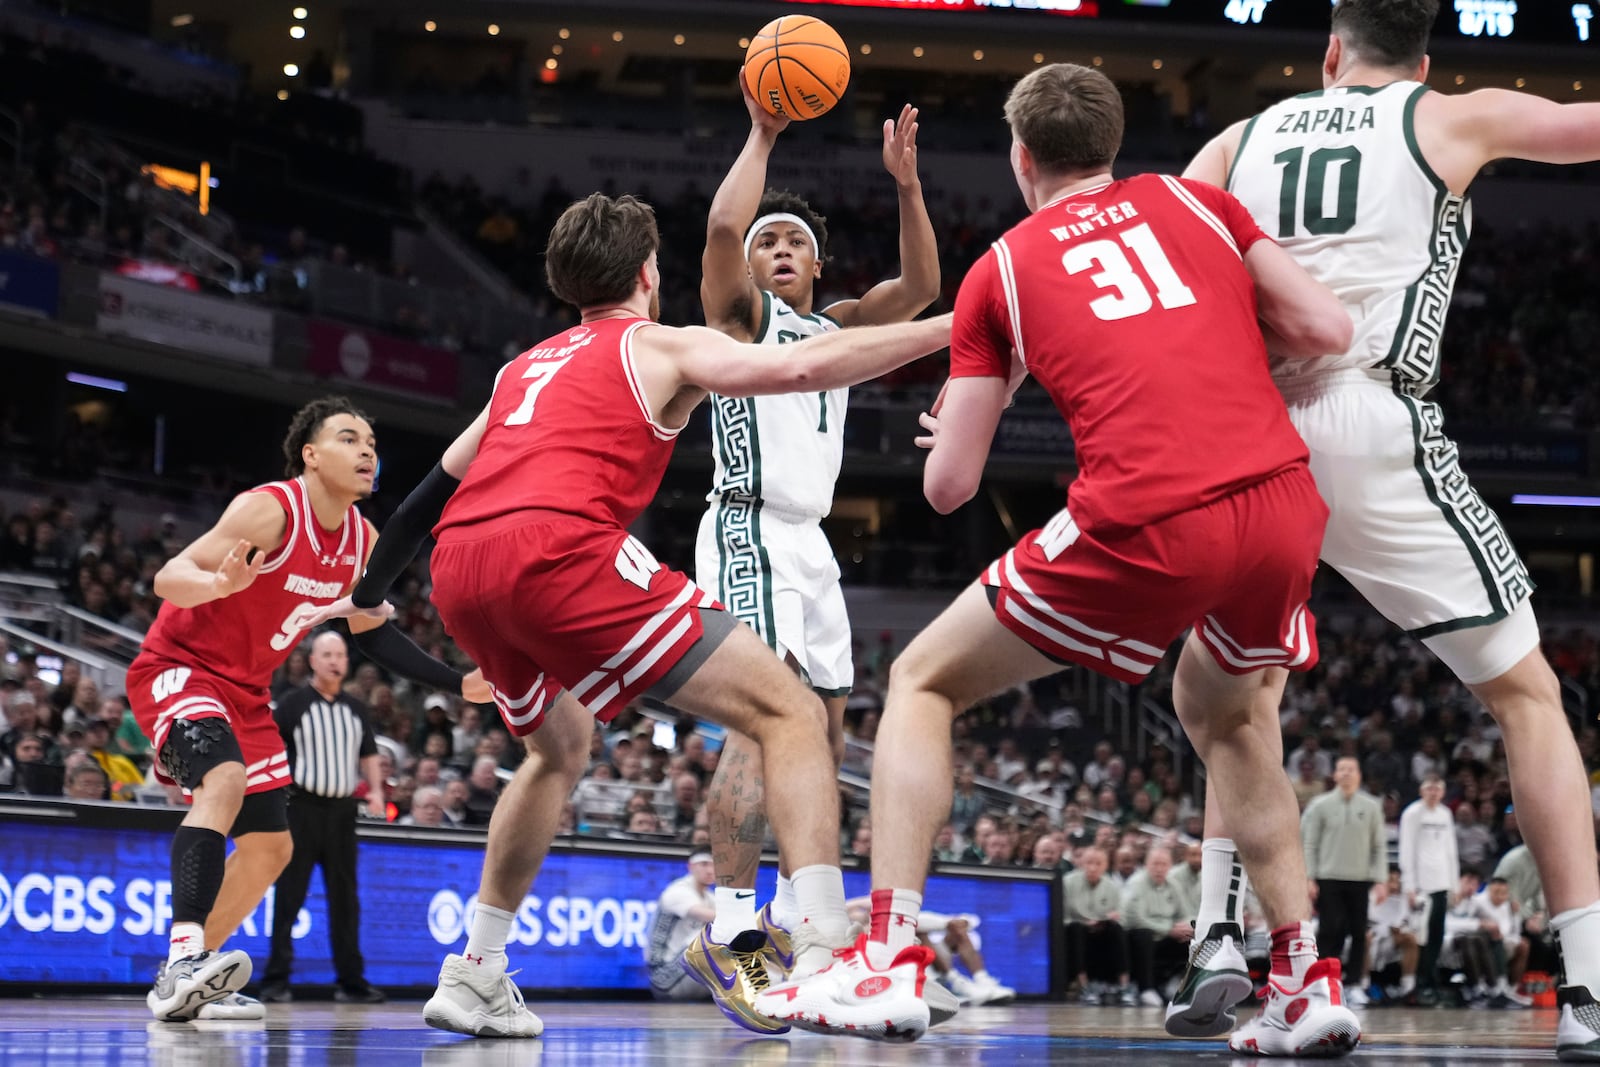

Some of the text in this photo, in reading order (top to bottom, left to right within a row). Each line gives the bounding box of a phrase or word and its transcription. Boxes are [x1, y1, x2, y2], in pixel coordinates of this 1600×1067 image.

[1274, 106, 1375, 134] ZAPALA
[1273, 145, 1362, 238] 10
[1049, 201, 1139, 242] WINTER
[1061, 222, 1198, 321] 31
[504, 354, 574, 426] 7
[614, 533, 662, 592] W
[1032, 506, 1082, 563] W
[283, 573, 344, 599] WISCONSIN
[269, 602, 318, 652] 9
[151, 666, 192, 704] W
[12, 872, 116, 935] CBS
